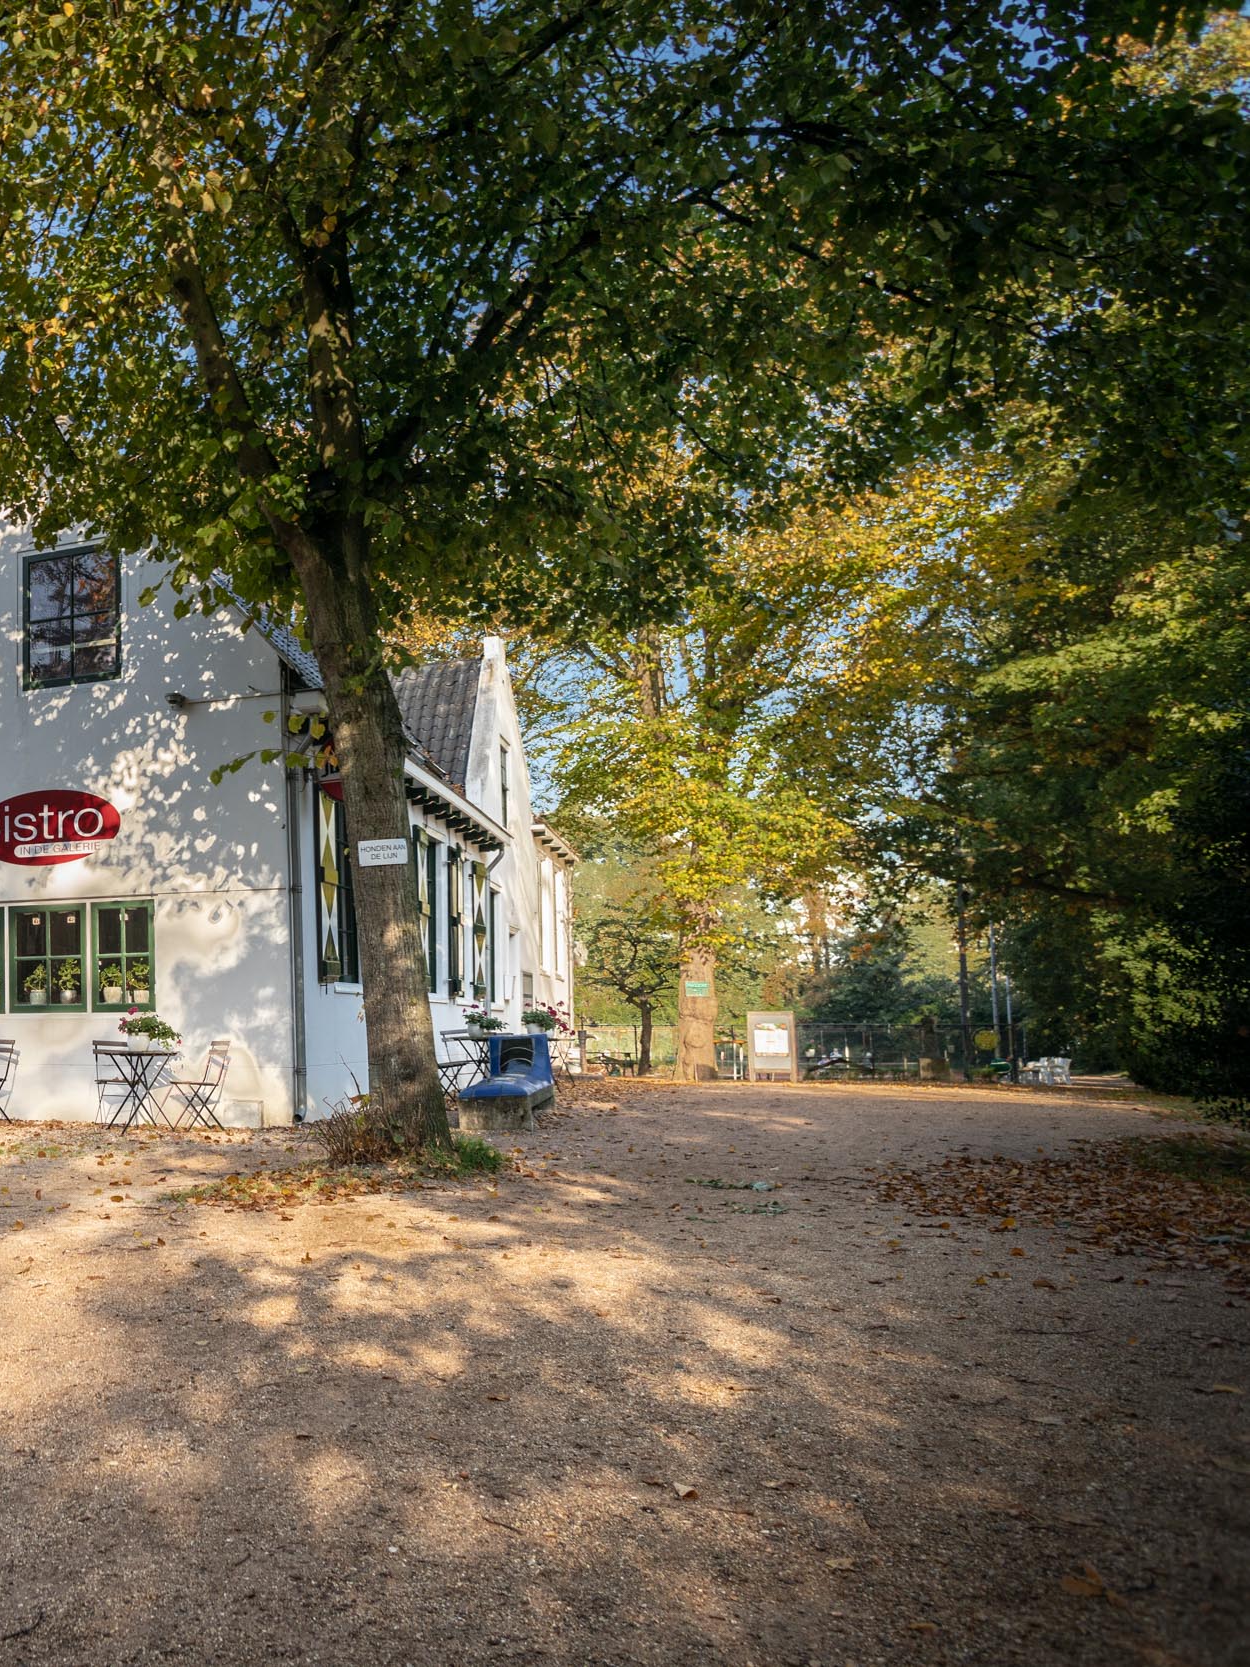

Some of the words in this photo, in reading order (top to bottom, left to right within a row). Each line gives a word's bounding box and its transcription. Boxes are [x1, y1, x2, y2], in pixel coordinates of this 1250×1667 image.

[19, 846, 32, 855] IN
[34, 844, 50, 854] DE
[53, 841, 101, 853] GALERIE
[360, 845, 392, 853] HONDEN
